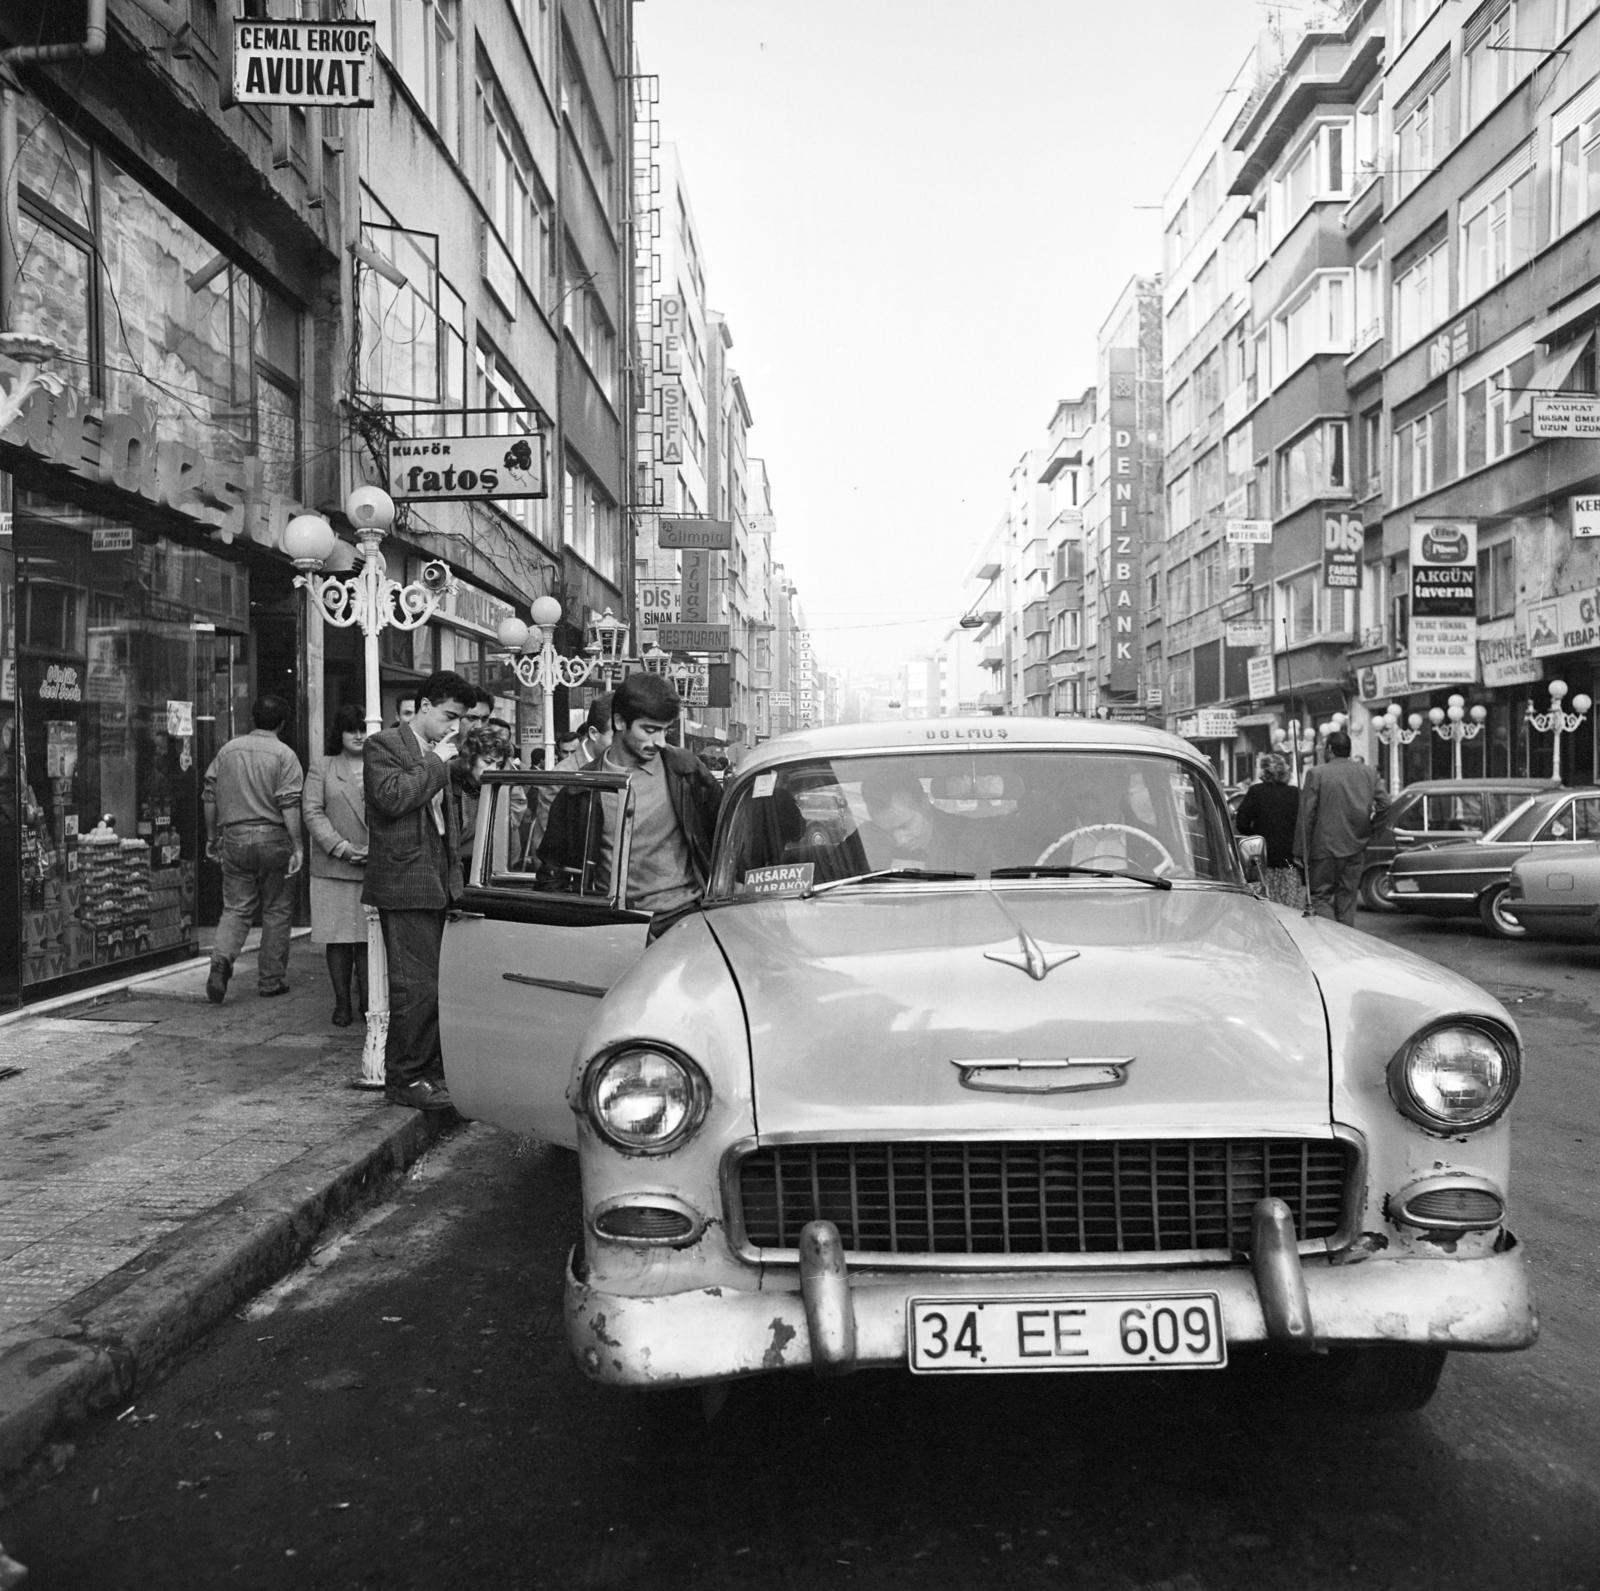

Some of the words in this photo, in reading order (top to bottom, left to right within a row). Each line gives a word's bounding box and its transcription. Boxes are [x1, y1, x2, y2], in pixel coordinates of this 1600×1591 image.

[241, 27, 301, 50] CEMAL
[308, 29, 370, 55] ERKOÇ
[245, 57, 365, 96] AVUKAT
[663, 300, 680, 369] OTEL
[1546, 404, 1594, 412] AVUKAT
[664, 388, 680, 458] SEFA
[1538, 414, 1570, 422] HASAN
[392, 443, 451, 456] KUAFÖR
[407, 463, 499, 493] fatoş
[668, 530, 724, 545] olimpia
[1115, 430, 1131, 659] DENİZBANK
[1415, 567, 1474, 583] AKGÜN
[643, 586, 671, 610] DİŞ
[1415, 584, 1474, 598] taverna
[644, 610, 672, 625] SİNAN
[660, 629, 729, 646] RESTAURANT
[747, 867, 805, 885] AKSARAY
[755, 878, 811, 893] KARAKÖY
[922, 1311, 982, 1359] 34
[1016, 1309, 1089, 1358] EE
[1119, 1306, 1211, 1356] 609
